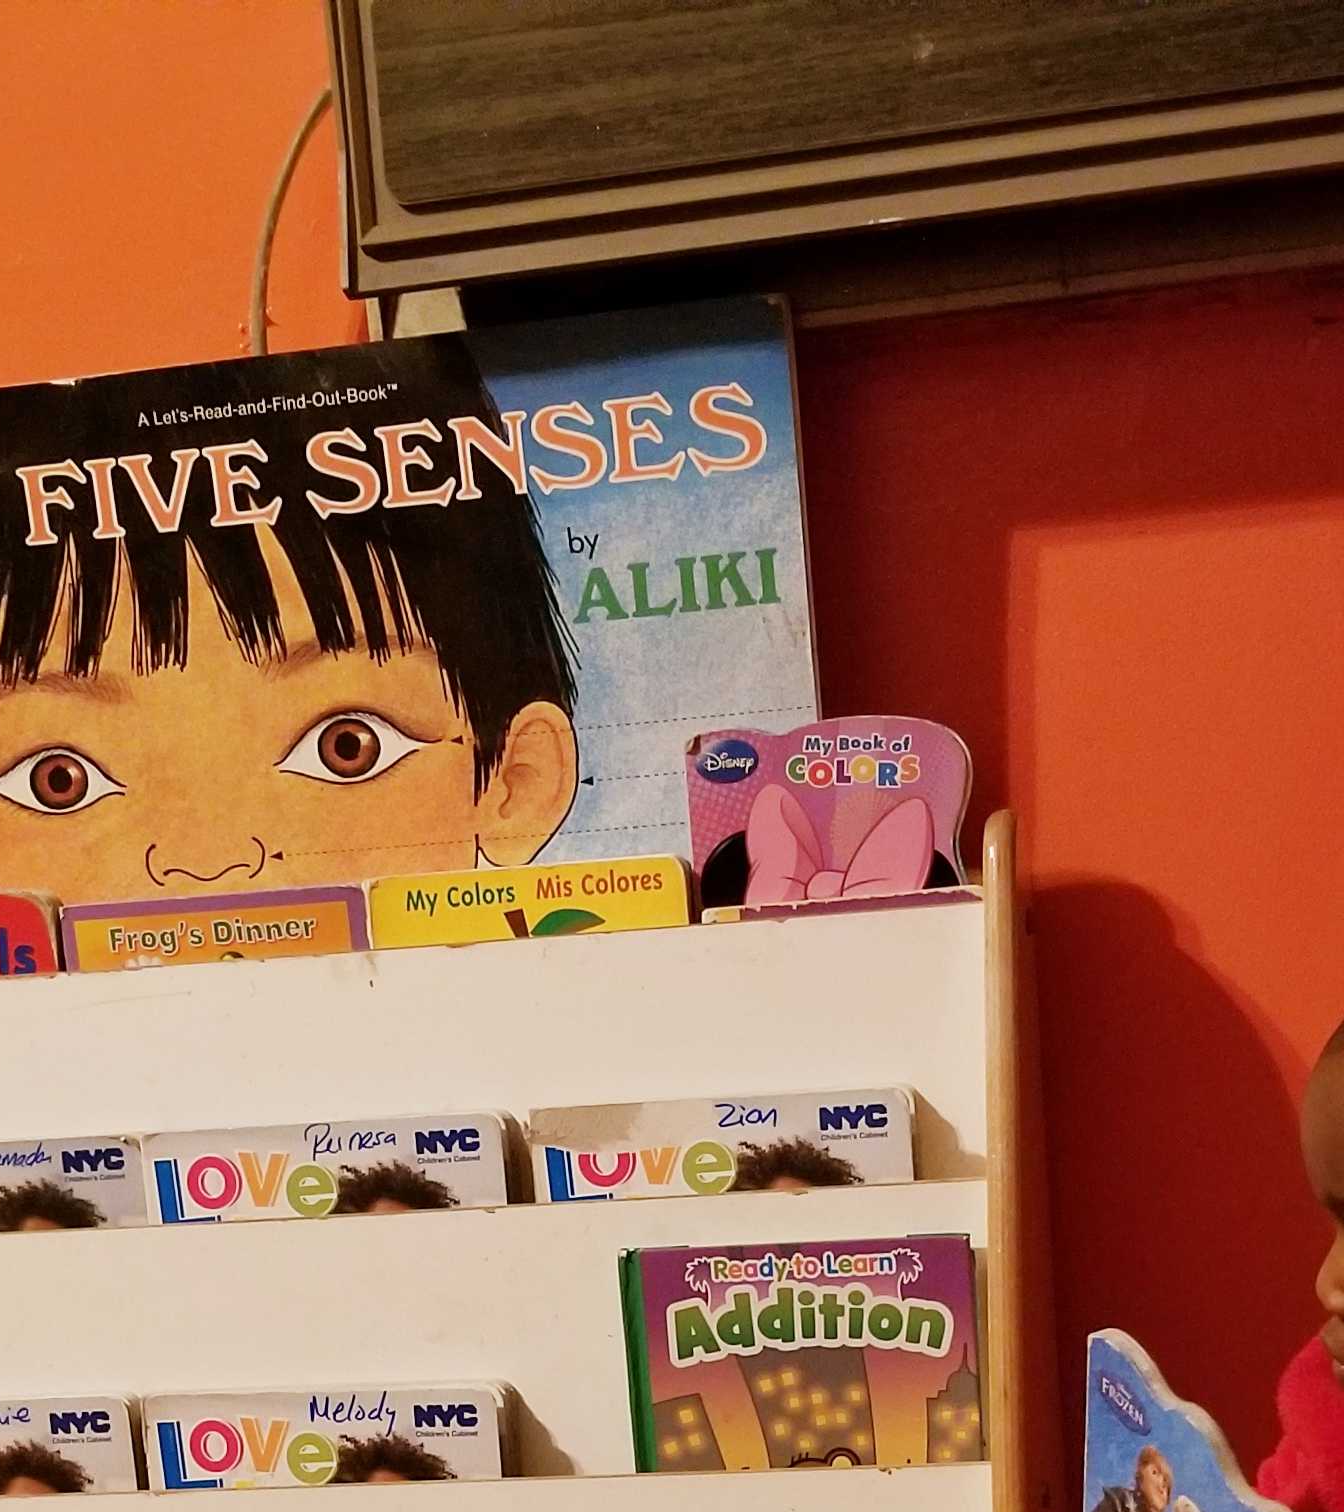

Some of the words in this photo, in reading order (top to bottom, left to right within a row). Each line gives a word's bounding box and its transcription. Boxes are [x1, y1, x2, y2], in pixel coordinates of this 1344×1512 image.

[137, 412, 150, 428] A
[16, 439, 282, 546] FIVE
[305, 382, 767, 519] SENSES
[566, 527, 599, 560] by
[573, 547, 782, 624] ALIKI
[805, 736, 832, 756] My
[838, 735, 884, 752] Book
[891, 736, 910, 752] of
[786, 755, 920, 788] COLORS
[406, 888, 438, 912] My
[445, 882, 516, 908] Colors
[535, 876, 578, 900] Mis
[581, 868, 663, 896] Colores
[107, 920, 204, 954] Frog's
[212, 915, 318, 944] Dinner
[714, 1103, 777, 1128] Zion
[819, 1104, 888, 1131] NYC
[415, 1129, 480, 1155] NYC
[61, 1148, 125, 1173] NYC
[711, 1254, 791, 1283] Ready
[791, 1252, 822, 1277] to
[824, 1250, 897, 1276] Learn
[670, 1284, 950, 1364] Addition
[49, 1411, 110, 1434] NYC
[309, 1391, 397, 1437] Melody
[414, 1404, 478, 1427] NYC
